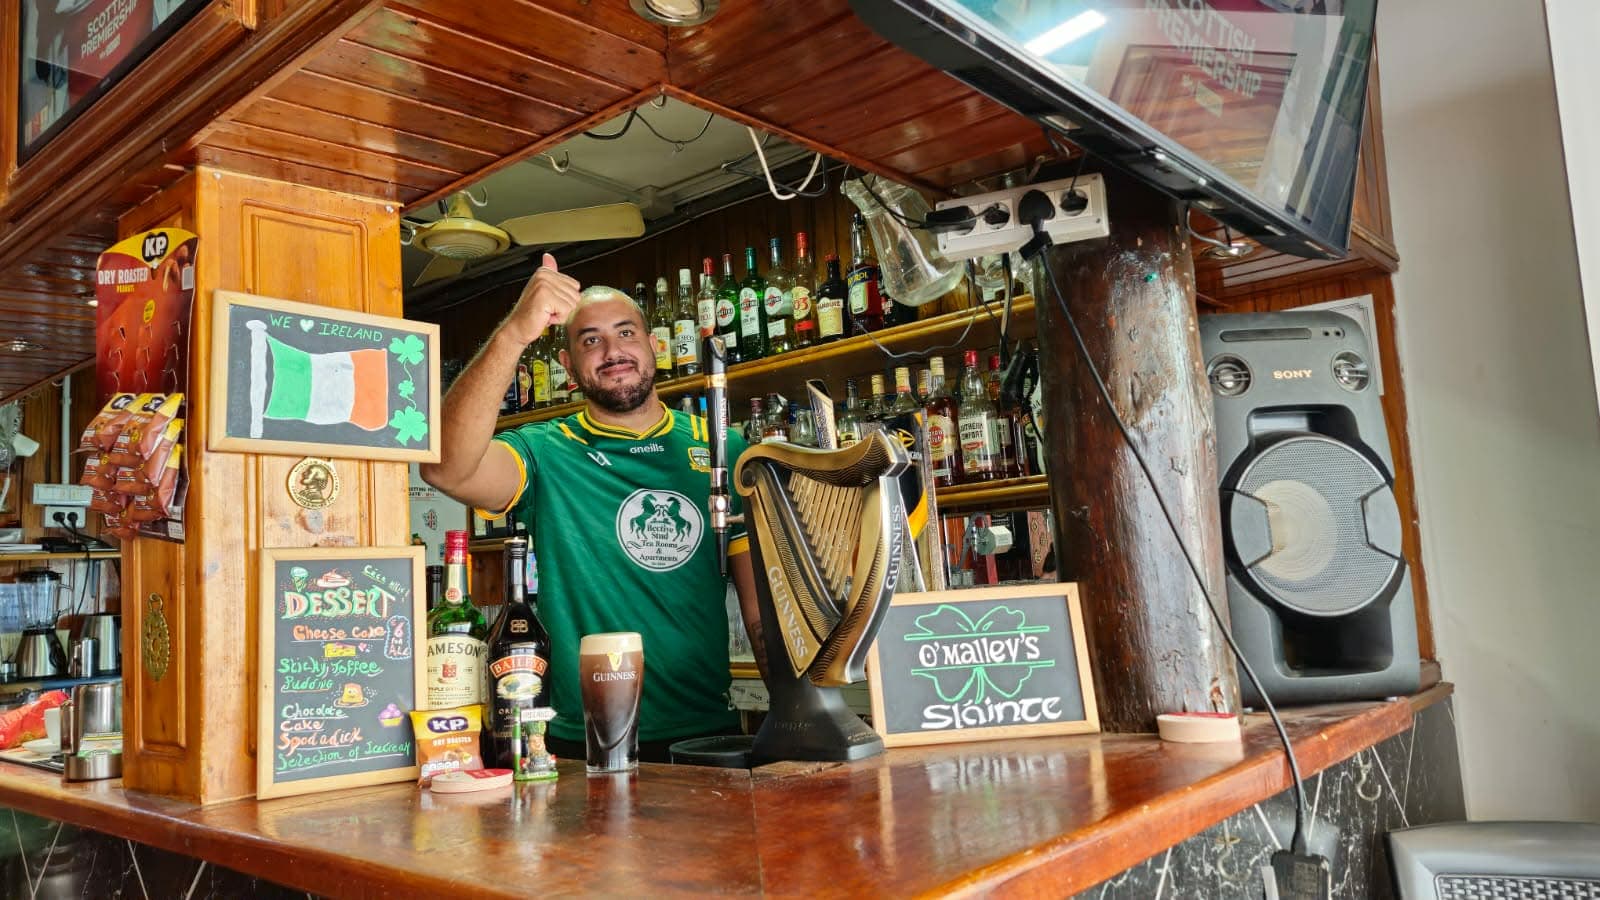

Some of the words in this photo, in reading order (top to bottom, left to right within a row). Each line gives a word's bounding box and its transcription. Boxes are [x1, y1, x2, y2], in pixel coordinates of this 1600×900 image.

[1160, 0, 1256, 64] COTTISH
[144, 235, 167, 257] KP
[98, 270, 116, 285] DRY
[118, 267, 148, 284] ROASTED
[270, 315, 293, 328] WE
[319, 322, 383, 342] IRELAND
[1273, 370, 1312, 379] SONY
[630, 443, 664, 454] oneills
[651, 532, 669, 540] Stud
[885, 503, 902, 590] GUINNESS
[640, 554, 678, 562] Apartments
[282, 585, 396, 619] DESSERT
[767, 565, 809, 659] GUINNESS
[293, 625, 347, 640] Cheese
[352, 626, 386, 639] Cake
[427, 642, 481, 657] AMESON
[277, 656, 330, 678] Sticky
[331, 658, 384, 677] Toffee
[593, 671, 636, 682] GUINNESS
[281, 703, 348, 718] Chocolate
[920, 696, 1062, 729] Sláinte
[280, 720, 325, 731] Cake
[431, 719, 465, 731] KP
[276, 749, 342, 771] Selection
[348, 745, 359, 760] of
